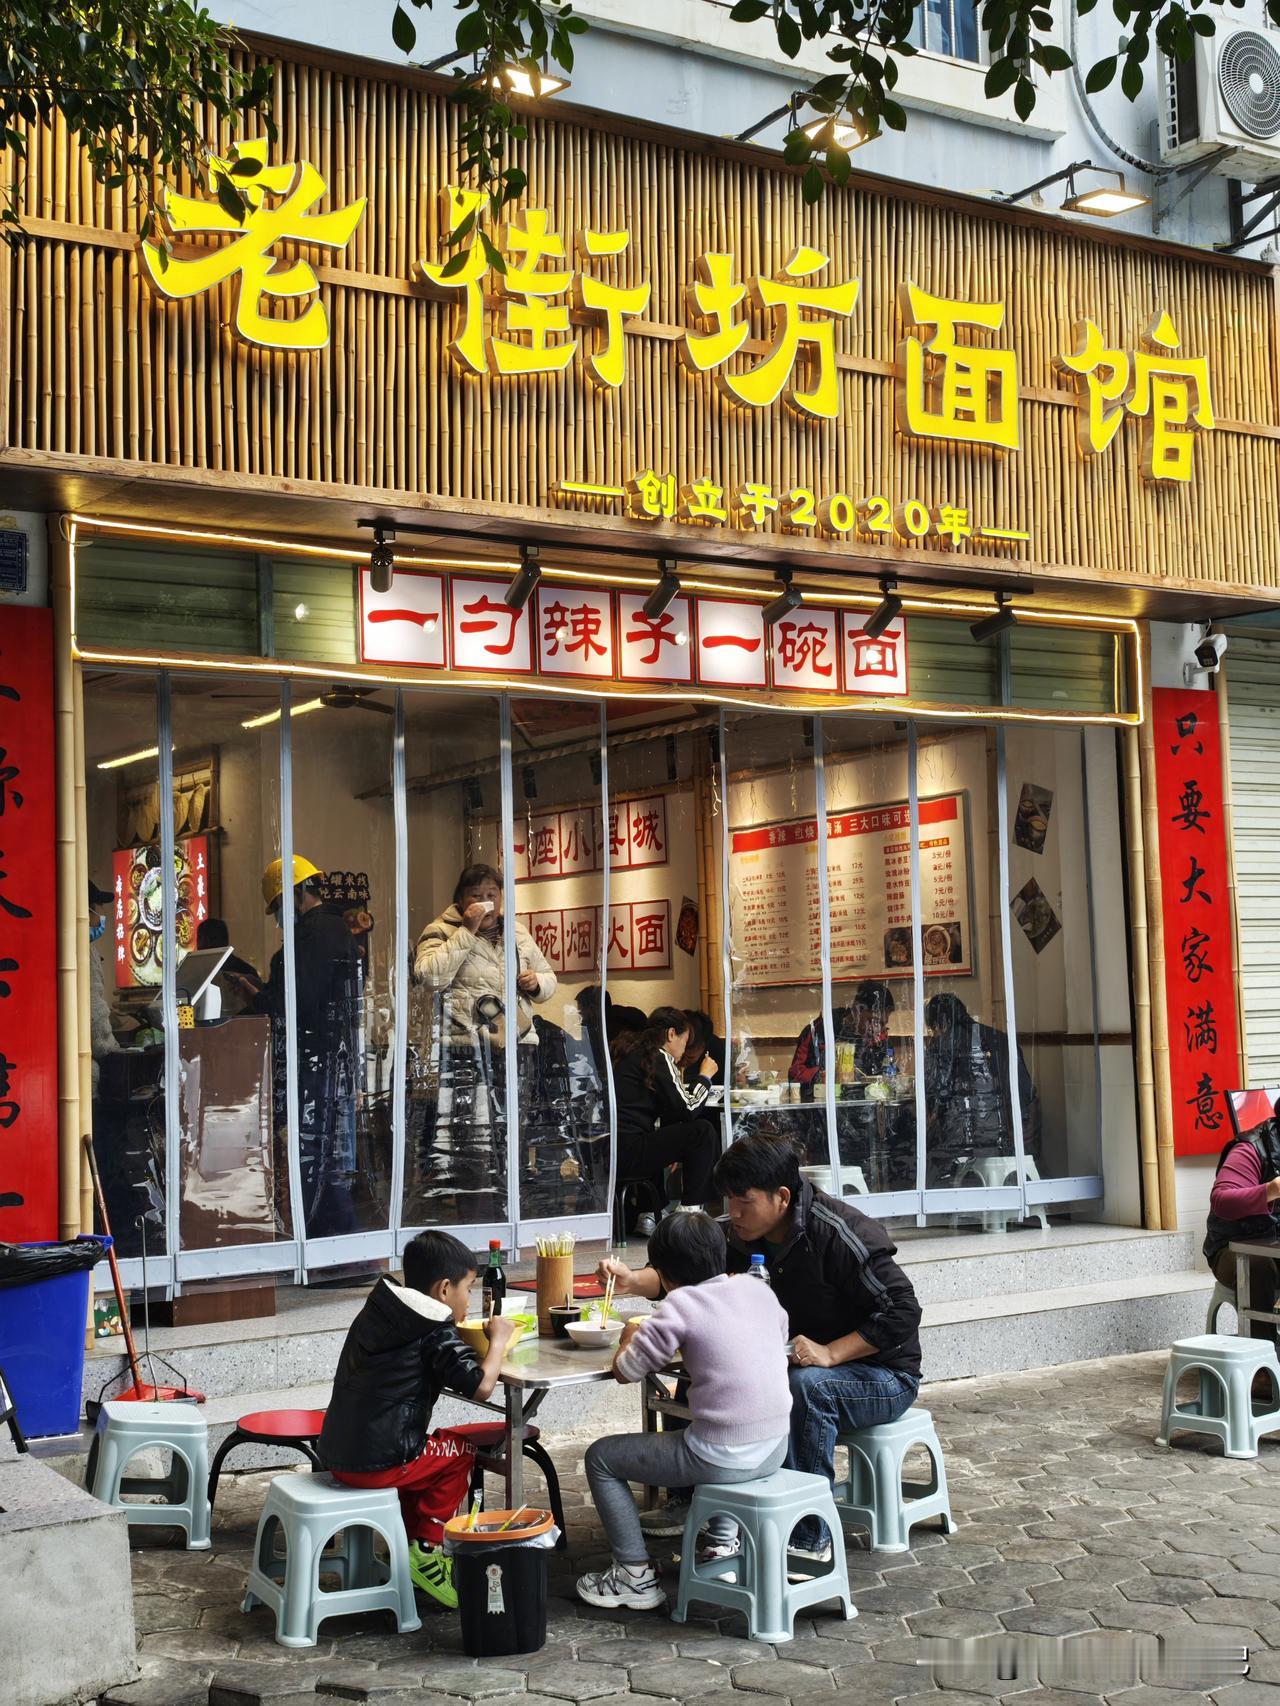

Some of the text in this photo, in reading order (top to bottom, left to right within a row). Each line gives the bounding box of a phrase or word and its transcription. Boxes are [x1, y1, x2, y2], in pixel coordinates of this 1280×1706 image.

[141, 138, 1215, 482] 老街坊面馆
[367, 594, 901, 677] 一勺辣子一碗面
[501, 810, 663, 867] 一座小县城
[534, 914, 666, 961] 碗烟火面
[1171, 712, 1224, 1130] 只要大家满意
